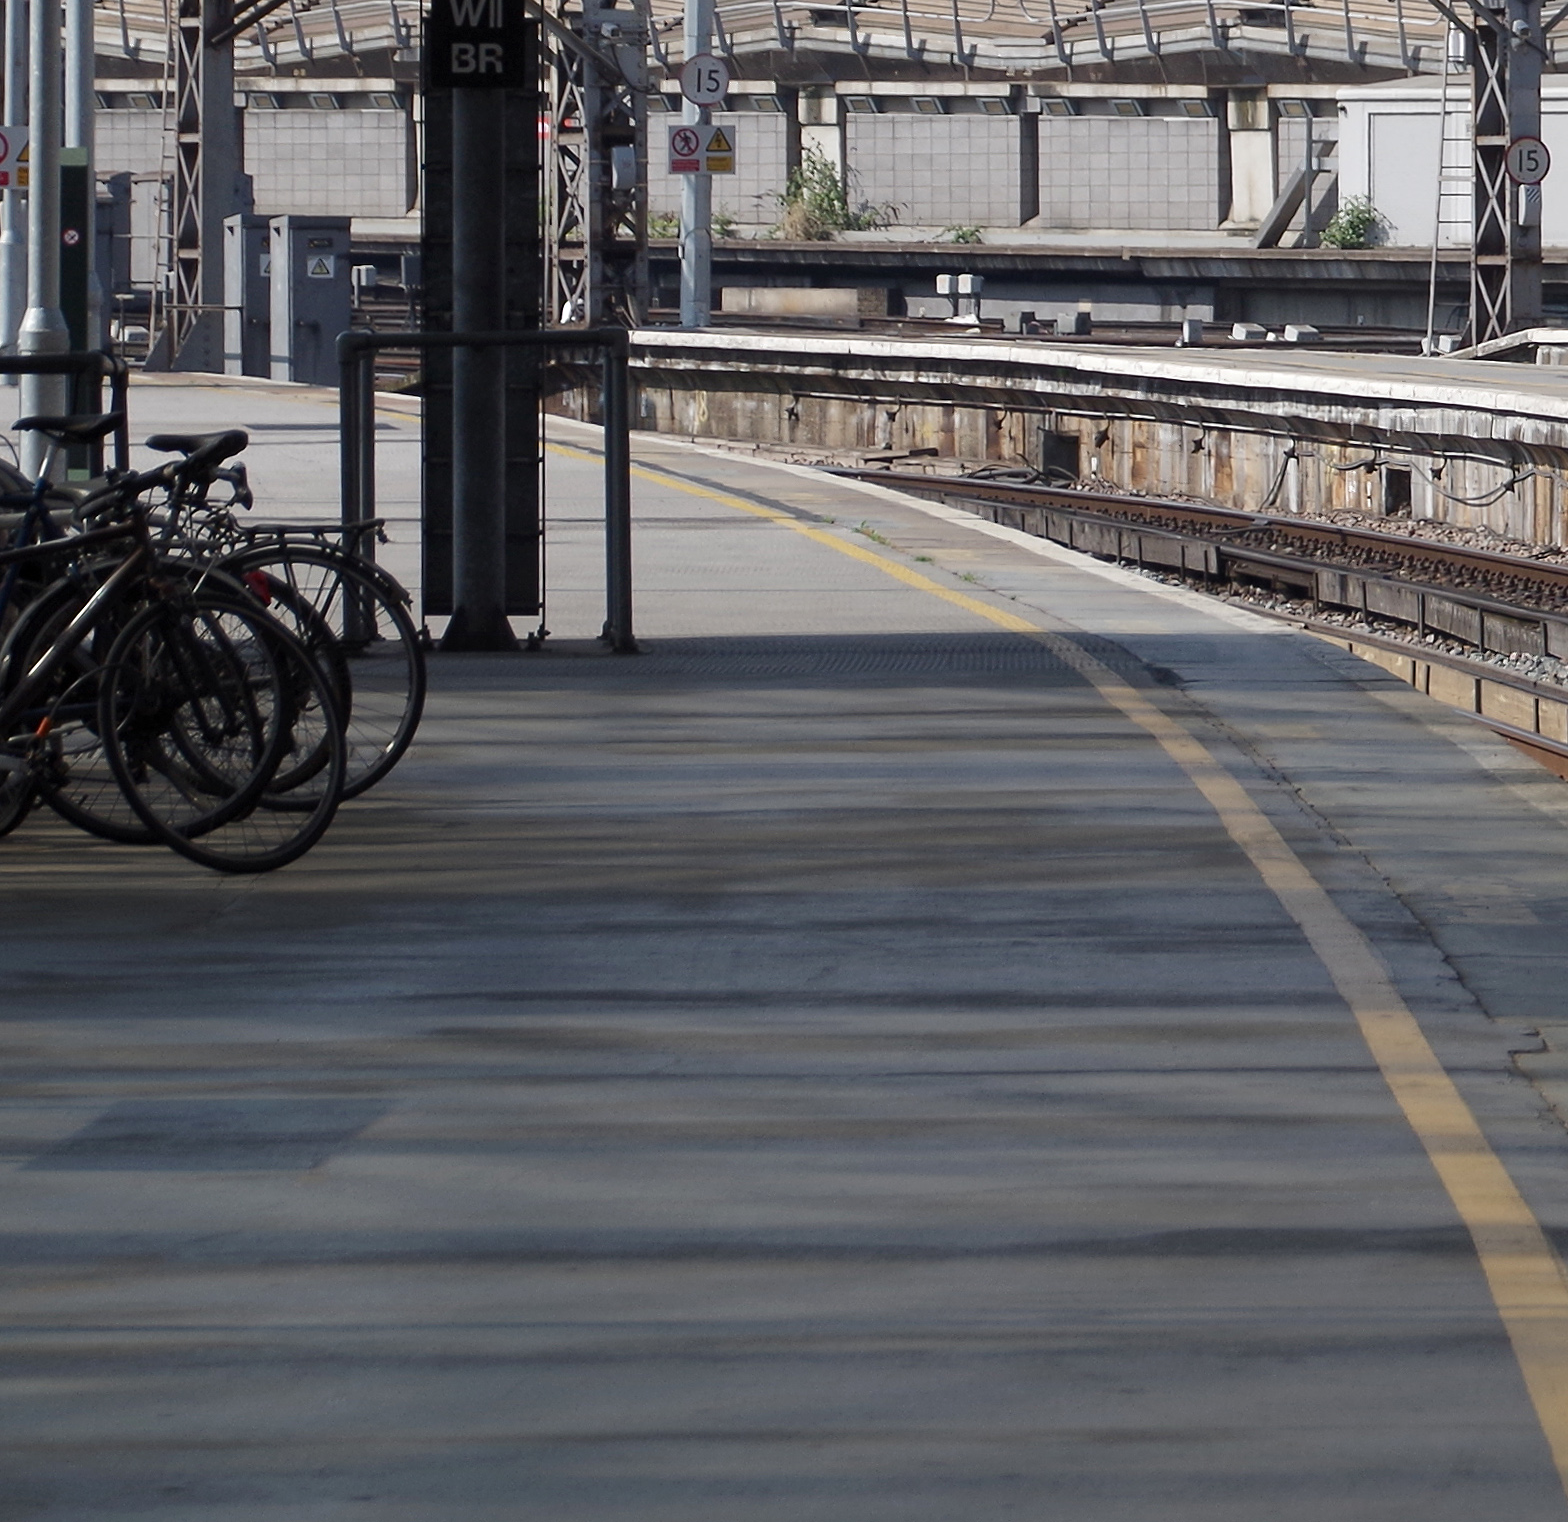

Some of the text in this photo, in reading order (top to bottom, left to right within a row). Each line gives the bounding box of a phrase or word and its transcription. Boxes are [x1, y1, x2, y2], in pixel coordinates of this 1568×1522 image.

[451, 42, 504, 74] BR
[696, 67, 720, 93] 15
[1519, 149, 1539, 173] 15
